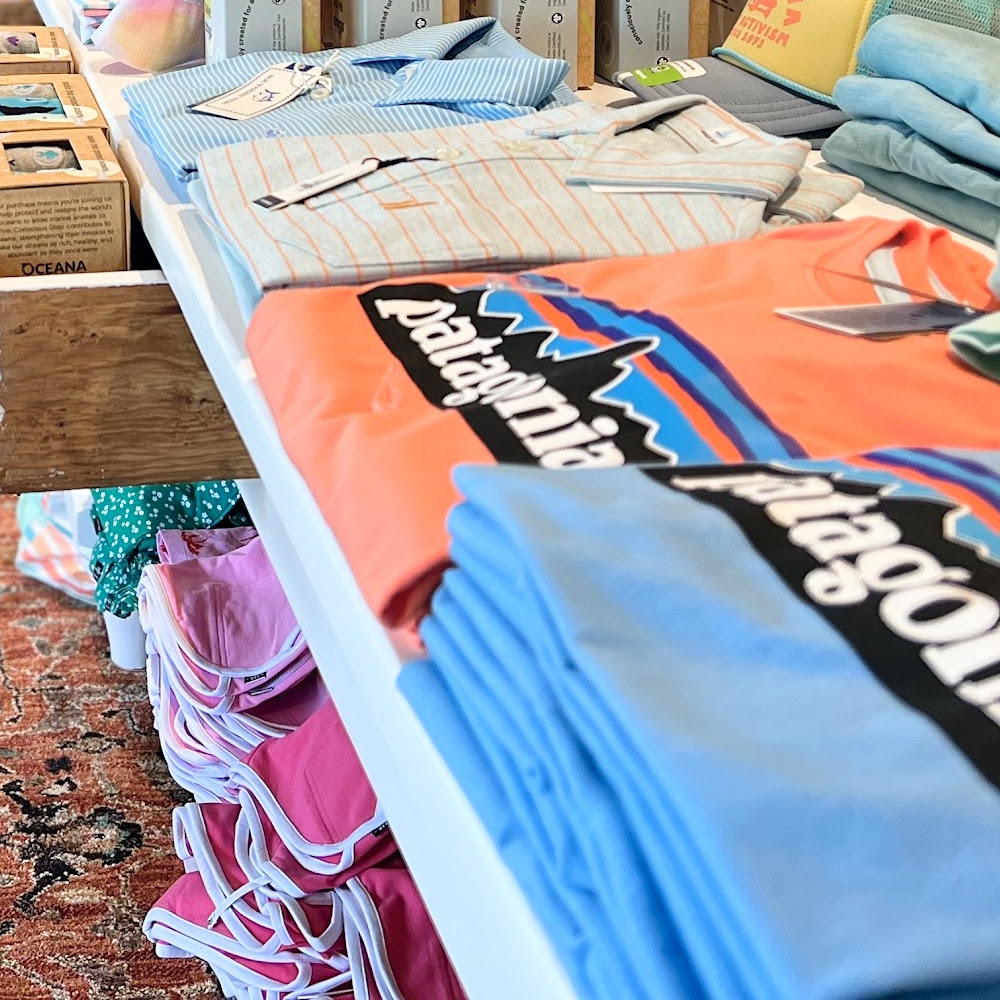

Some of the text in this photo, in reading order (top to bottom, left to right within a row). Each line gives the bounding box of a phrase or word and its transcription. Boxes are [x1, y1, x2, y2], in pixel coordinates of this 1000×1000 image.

[384, 0, 393, 10] for
[515, 4, 525, 34] created
[238, 17, 248, 46] created
[244, 5, 252, 16] for
[380, 11, 389, 40] created
[625, 5, 643, 45] consciously
[739, 16, 790, 47] ACTIVISM
[0, 211, 12, 219] help
[15, 209, 38, 217] protect
[6, 201, 35, 210] purchase
[81, 196, 102, 204] joining
[20, 233, 63, 241] strengthening
[21, 260, 87, 276] OCEANA
[374, 299, 625, 469] patagonia
[670, 471, 1000, 727] patagon
